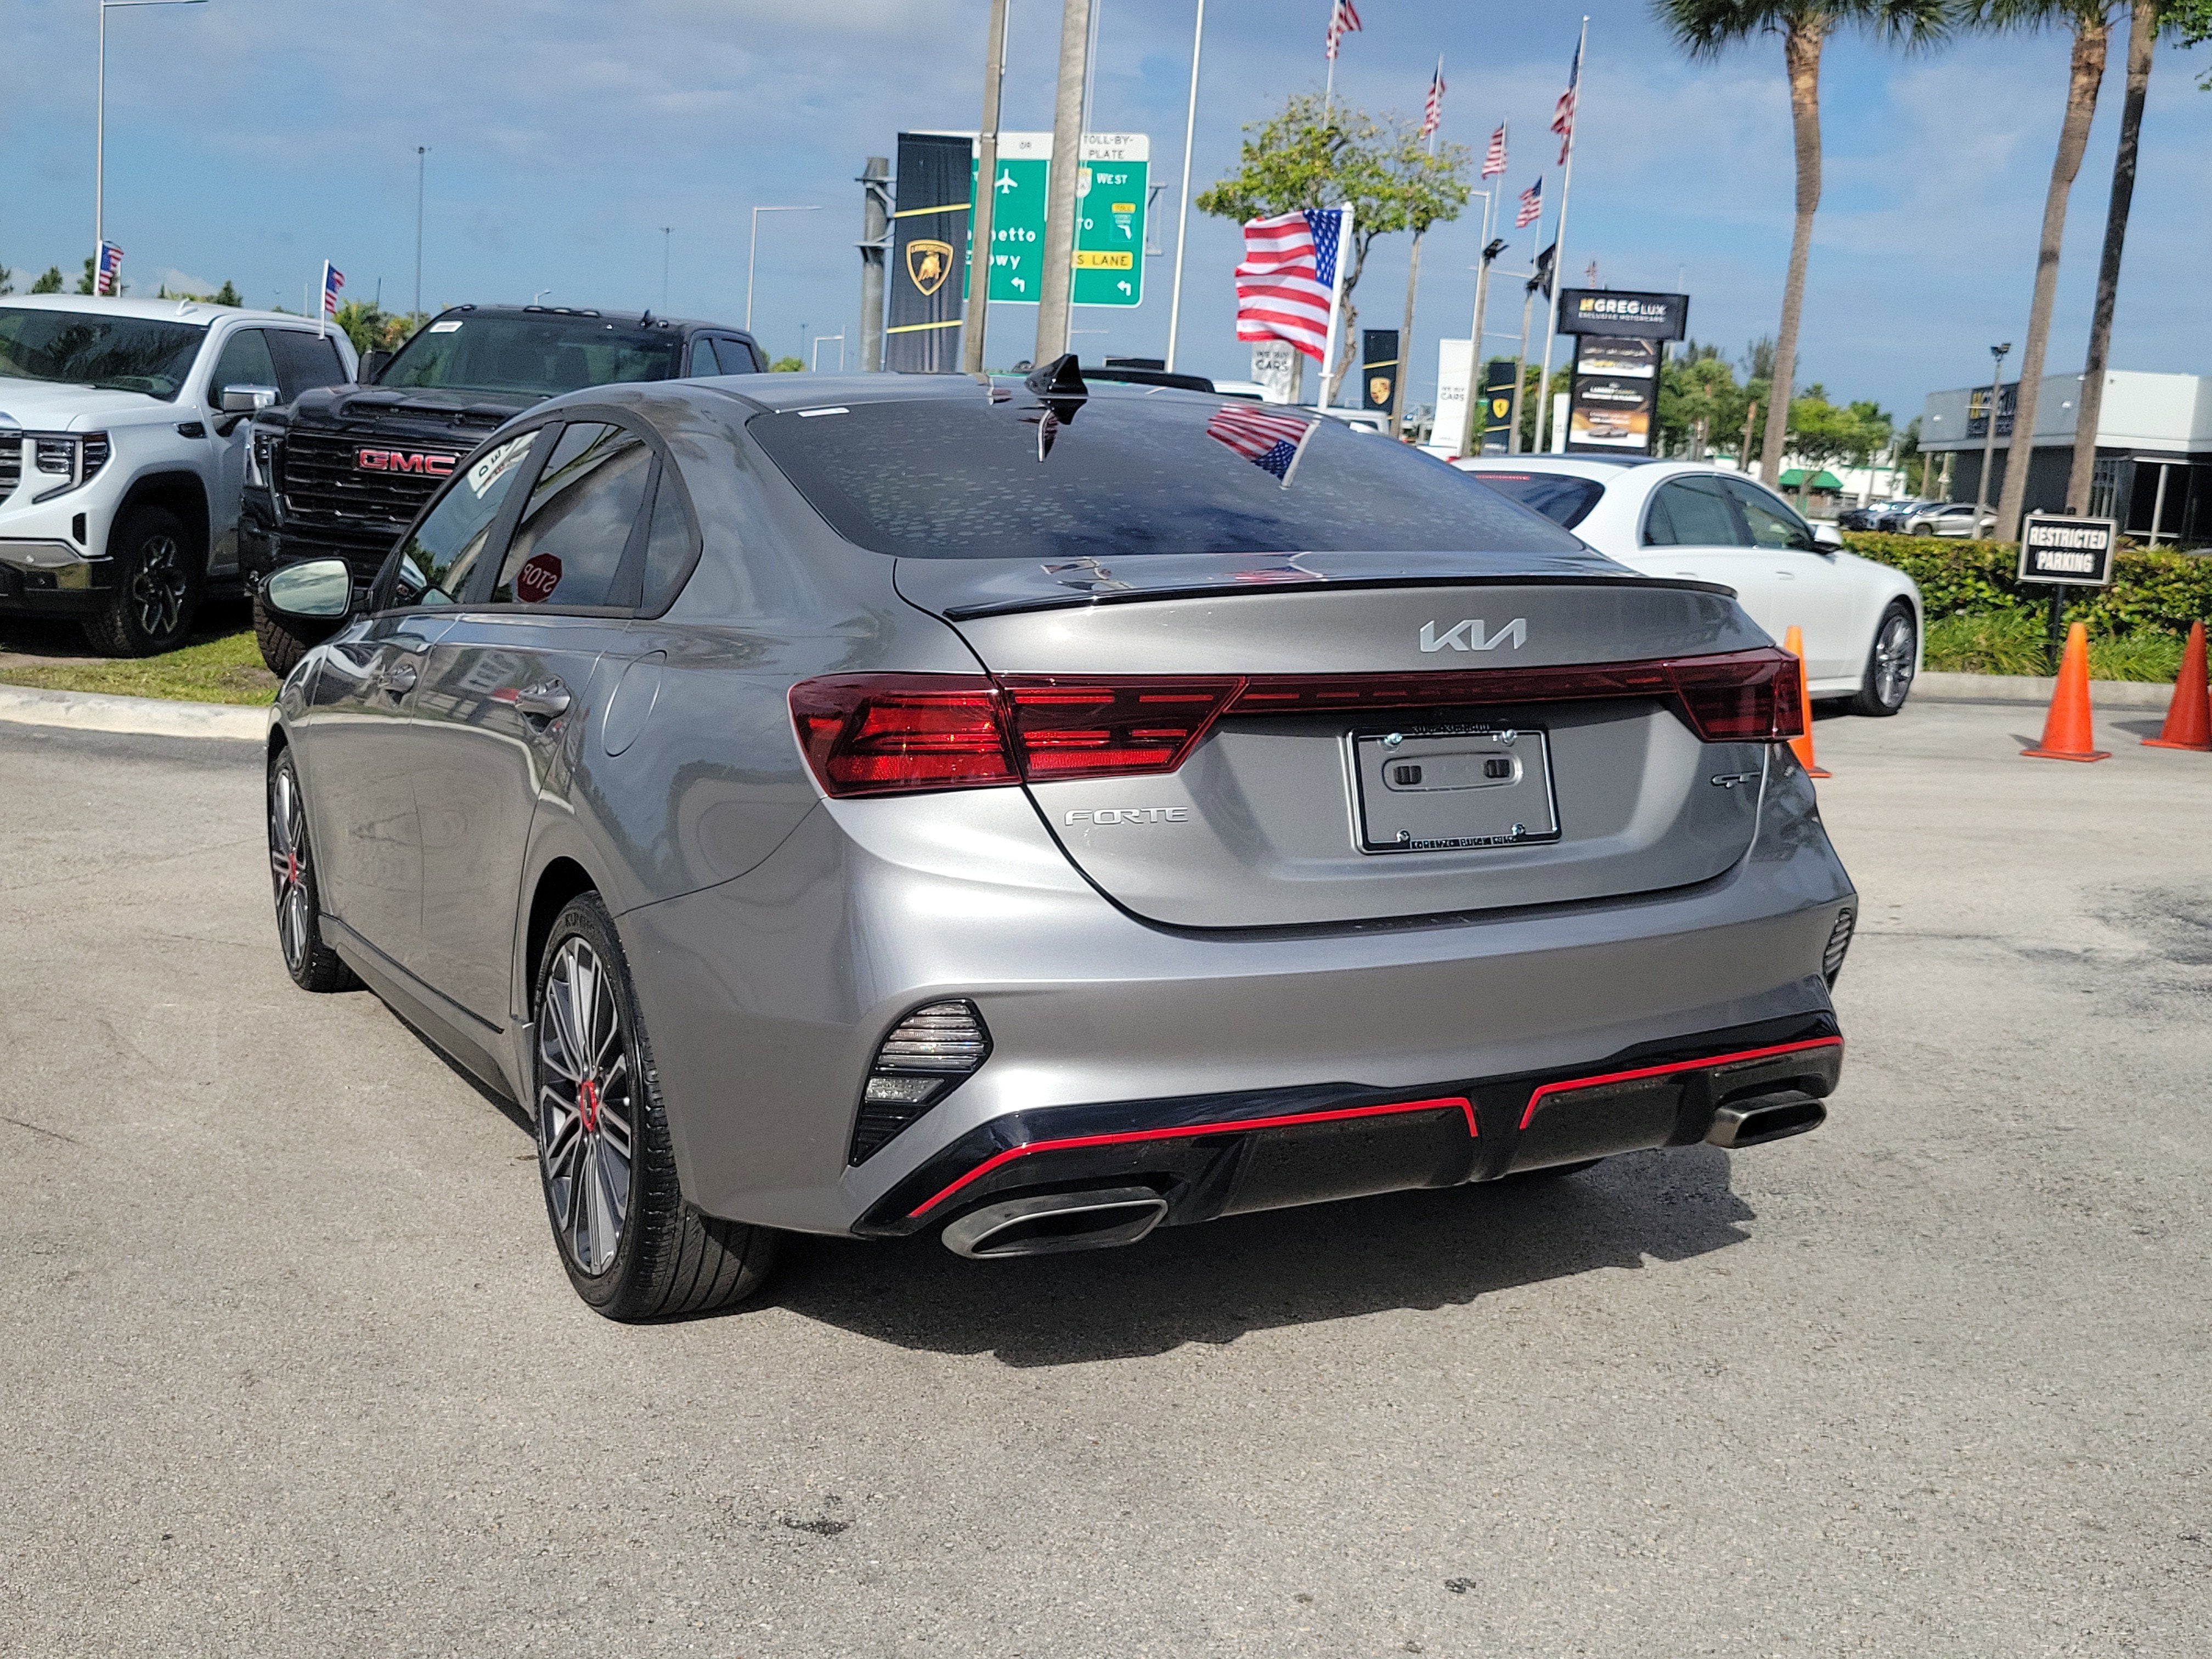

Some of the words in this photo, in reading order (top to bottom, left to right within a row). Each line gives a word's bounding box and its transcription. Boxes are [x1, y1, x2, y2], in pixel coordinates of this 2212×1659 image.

[1088, 149, 1125, 160] PLATE
[1096, 172, 1128, 185] WEST
[1092, 255, 1129, 266] LANE
[1255, 359, 1289, 371] CARS
[1440, 392, 1464, 402] CARS
[359, 449, 456, 476] GMC
[2029, 526, 2109, 550] RESTRICTED
[2036, 550, 2095, 573] PARKING
[1420, 617, 1526, 653] KIA
[1712, 771, 1761, 788] GT
[1064, 806, 1189, 826] FORTE
